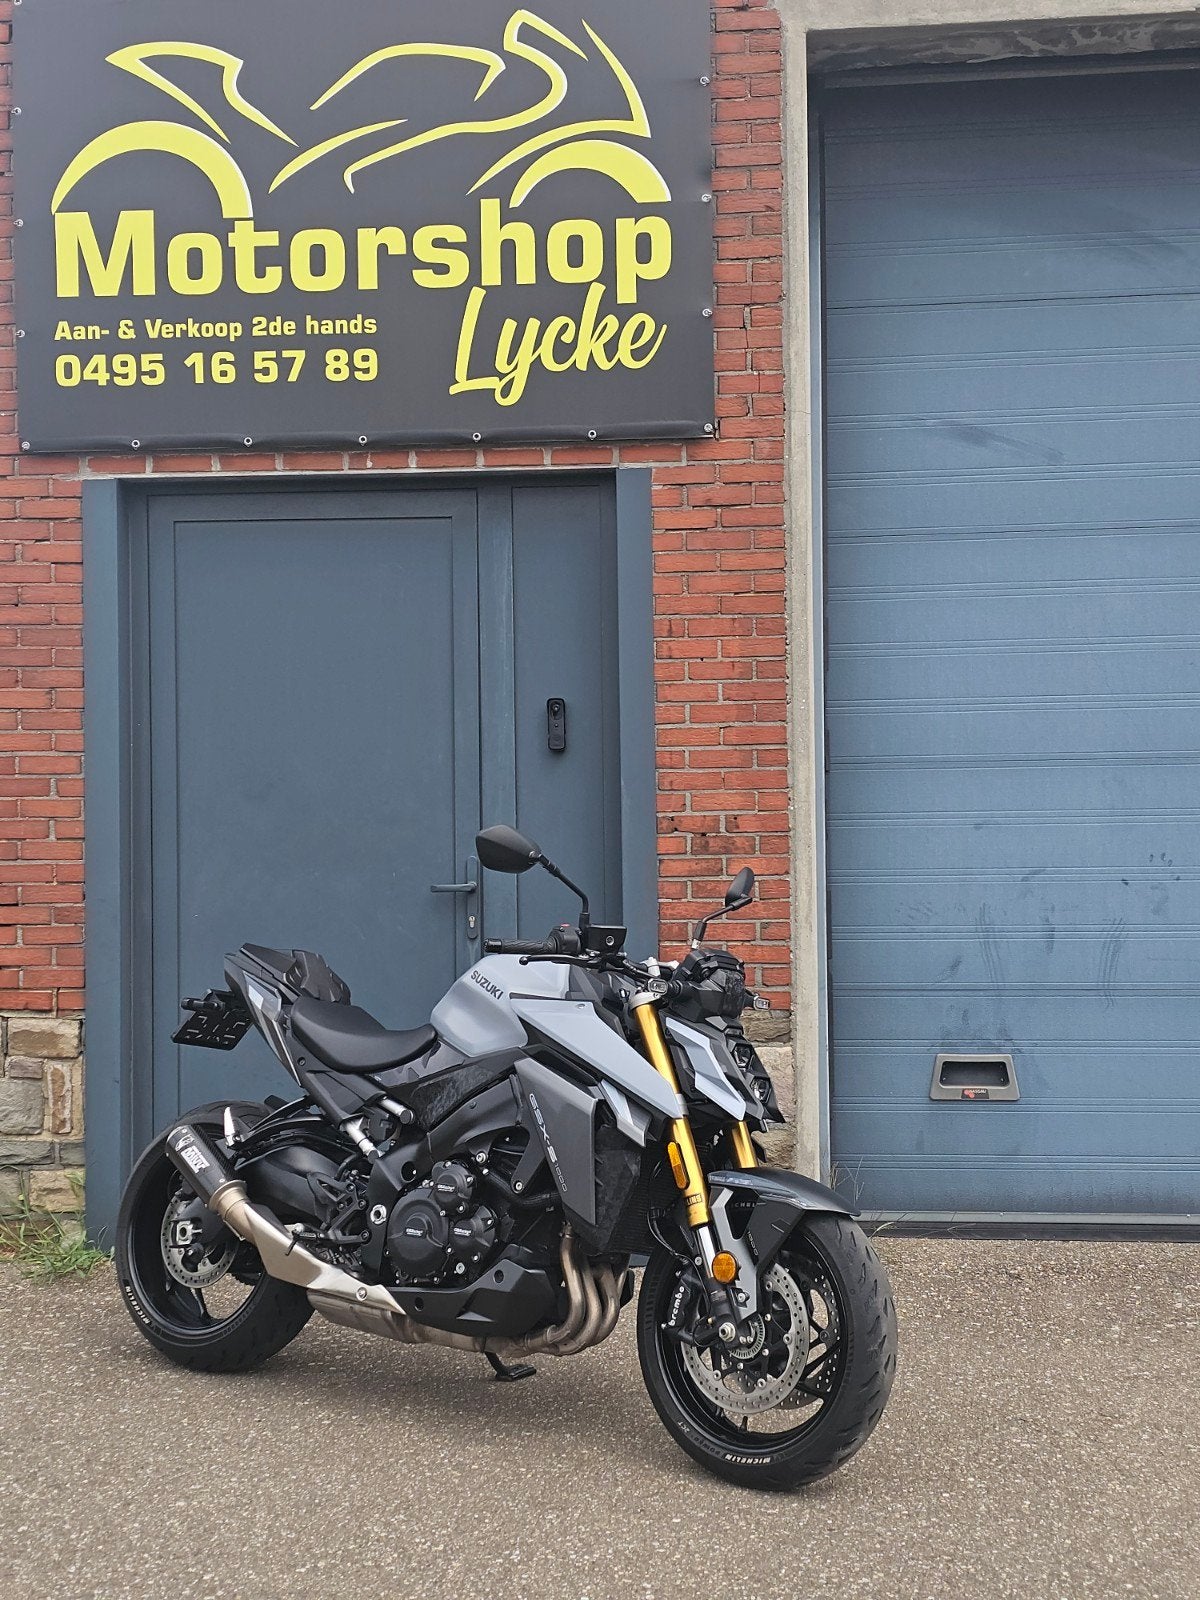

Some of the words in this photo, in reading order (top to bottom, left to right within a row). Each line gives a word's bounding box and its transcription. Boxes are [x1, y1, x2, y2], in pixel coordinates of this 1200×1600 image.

[53, 197, 672, 305] Motorshop
[55, 320, 110, 340] Aan-
[117, 319, 136, 340] &
[145, 318, 243, 341] Verkoop
[252, 316, 296, 337] 2de
[305, 314, 377, 335] hands
[449, 281, 668, 407] Lycke
[55, 353, 166, 387] 0495
[184, 351, 237, 385] 16
[253, 349, 306, 384] 57
[324, 347, 379, 382] 89
[469, 969, 504, 1001] SUZUKI
[124, 1285, 151, 1325] MICHELIN
[667, 1285, 685, 1328] brembo
[725, 1453, 771, 1465] MICHELIN
